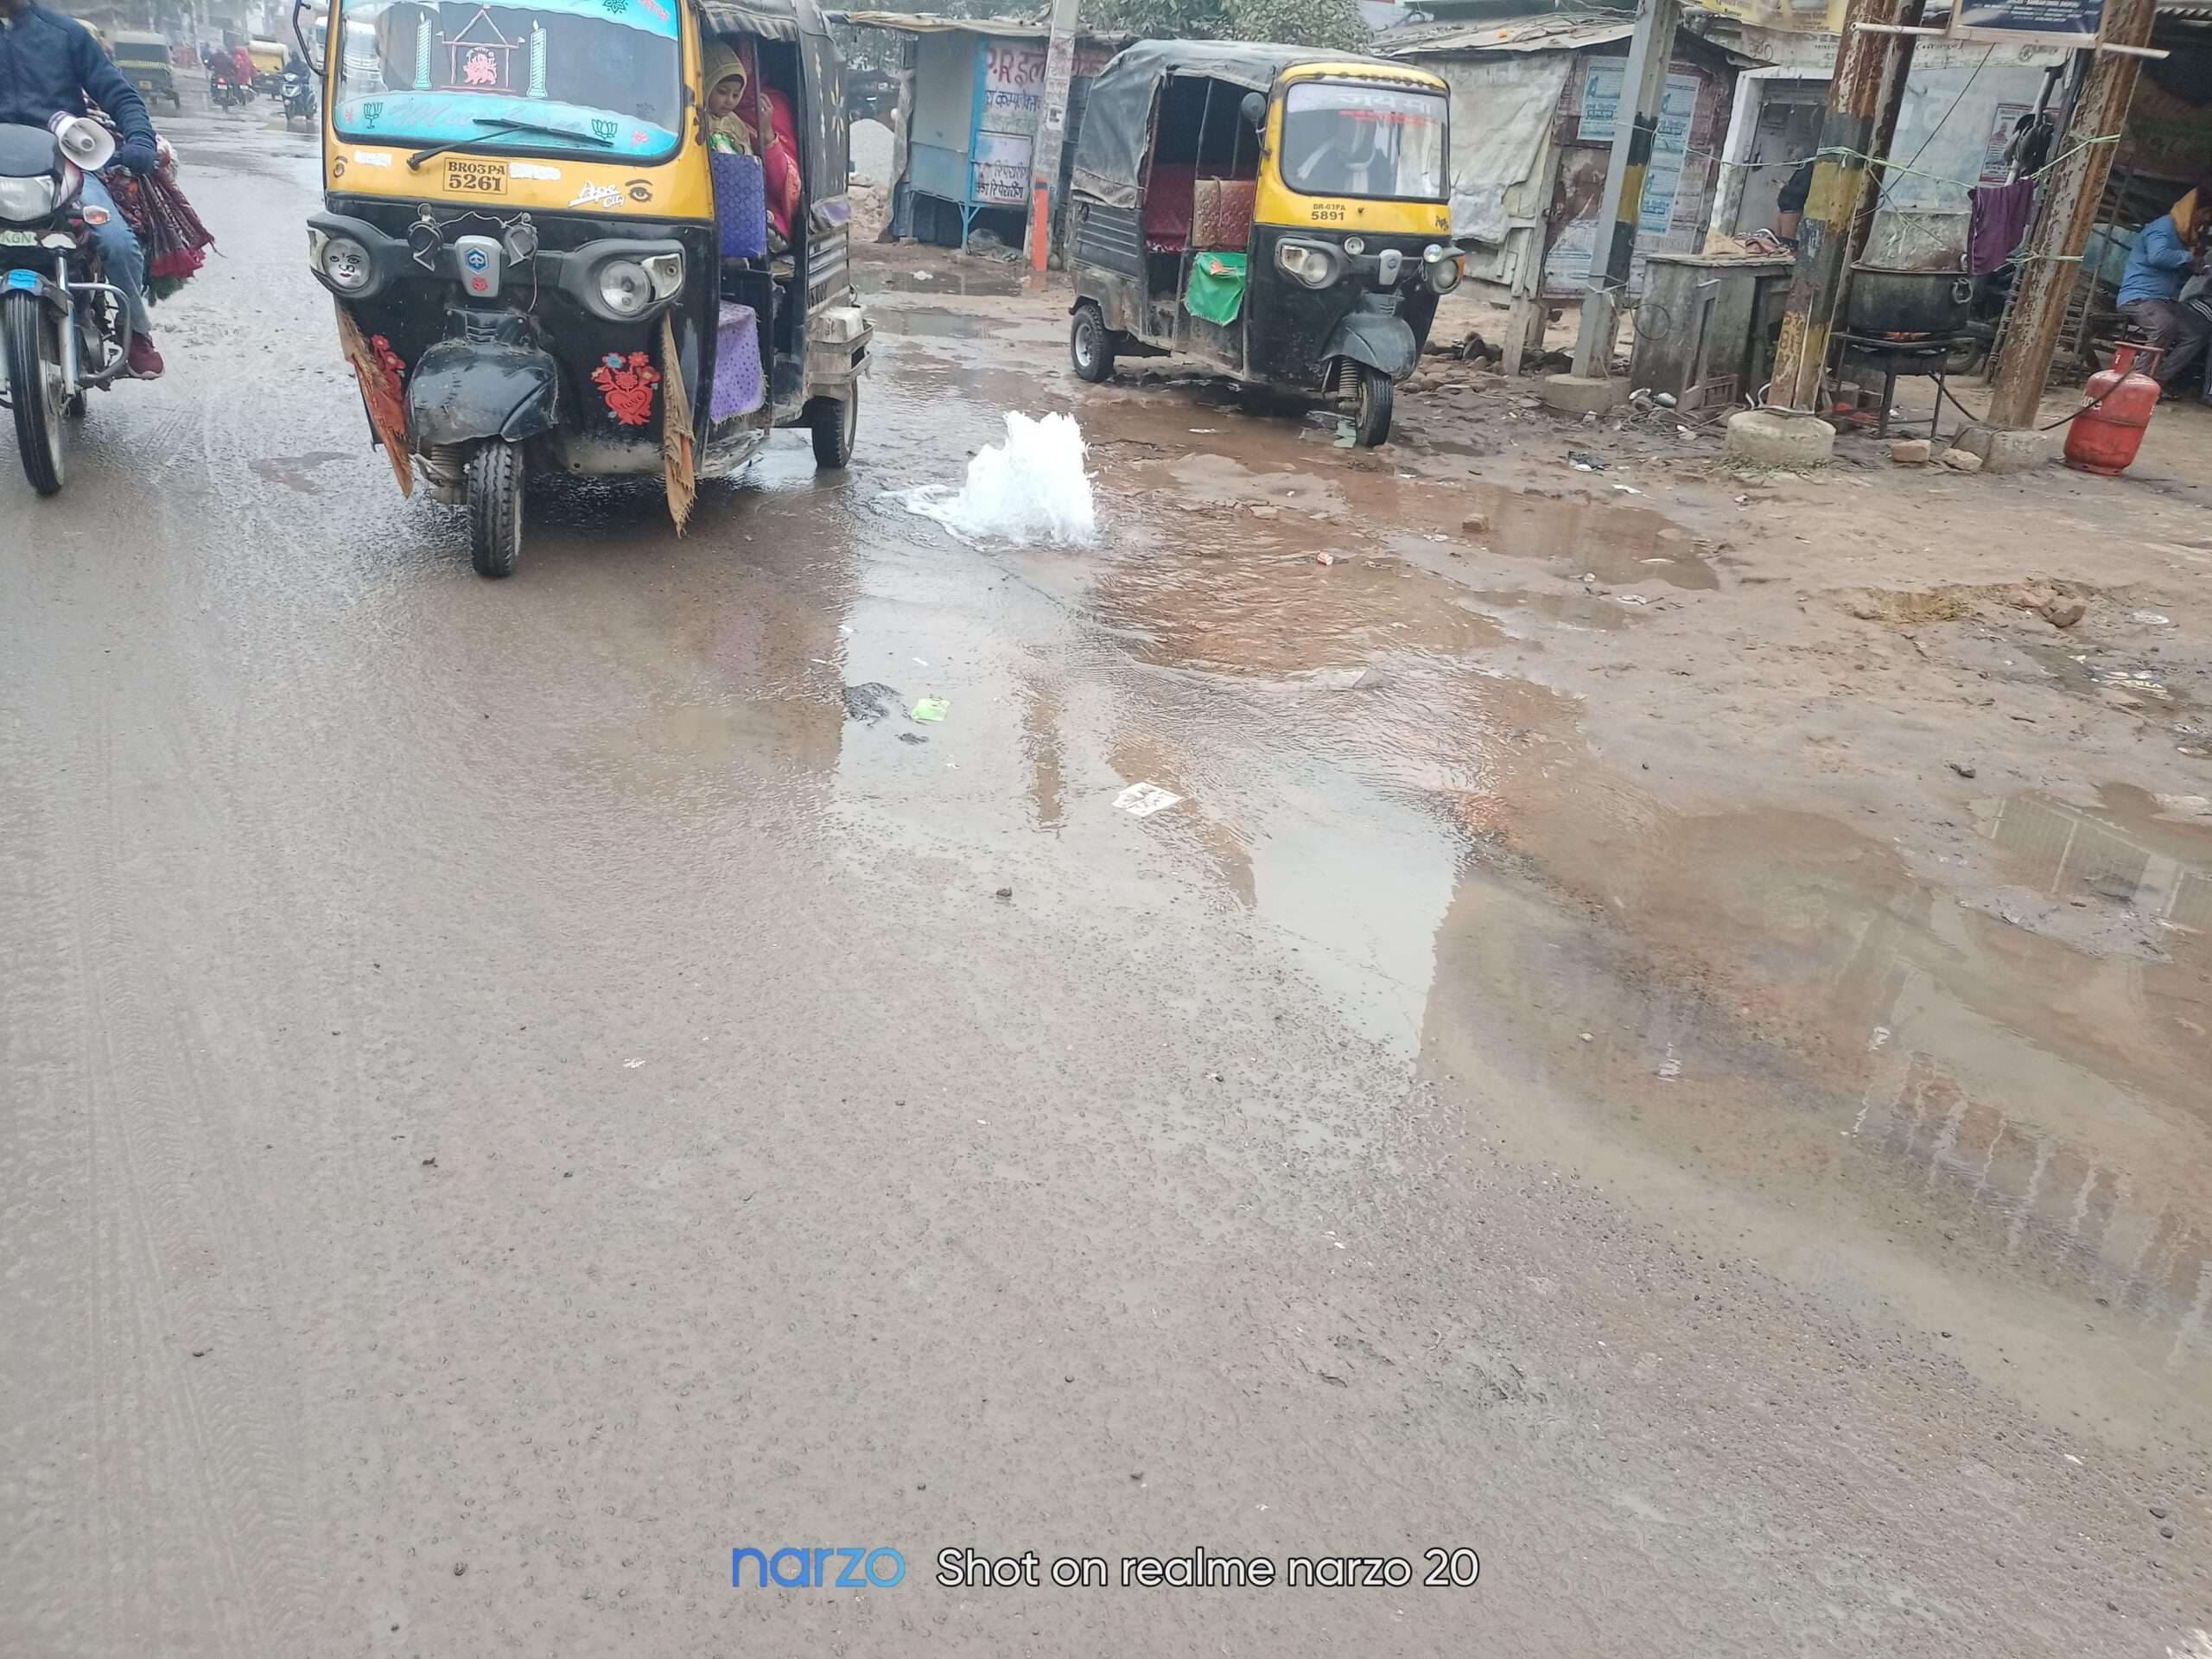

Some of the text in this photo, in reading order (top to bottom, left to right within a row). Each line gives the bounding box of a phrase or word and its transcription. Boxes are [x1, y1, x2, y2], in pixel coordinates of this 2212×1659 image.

[448, 161, 505, 175] BR03PA
[448, 173, 501, 192] 5261
[1311, 210, 1344, 221] 5891
